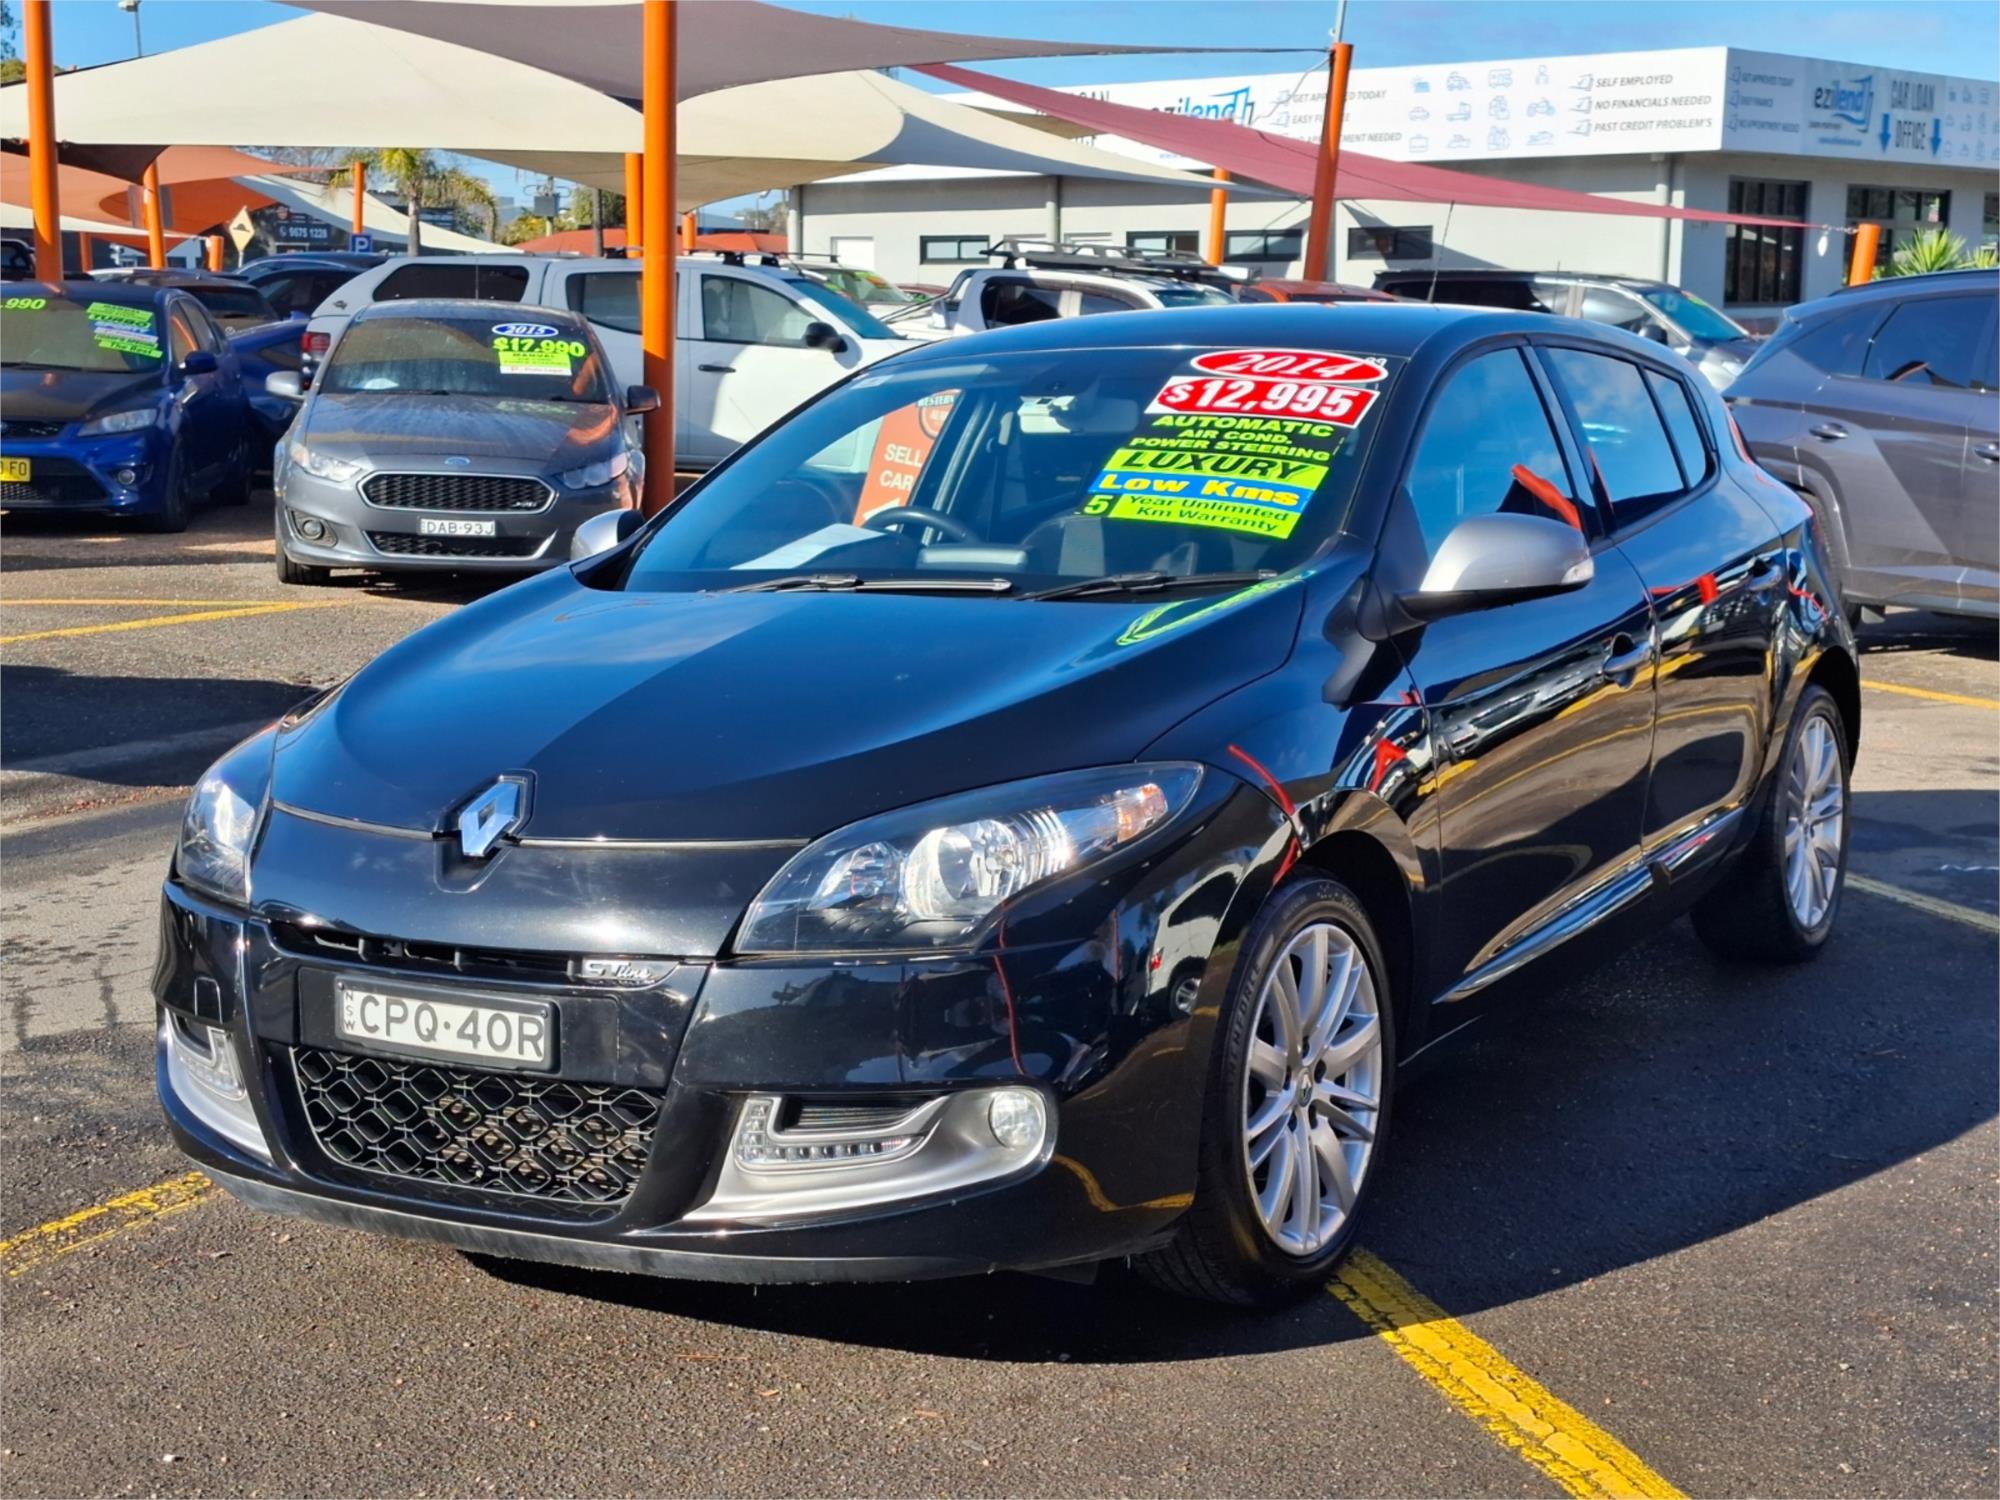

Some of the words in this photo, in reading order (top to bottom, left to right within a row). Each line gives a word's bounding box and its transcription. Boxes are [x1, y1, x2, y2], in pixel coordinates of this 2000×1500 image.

[1596, 78, 1618, 88] SELF
[1619, 74, 1673, 87] EMPLOYED
[1595, 100, 1610, 110] NO
[1612, 97, 1669, 109] FINANCIALS
[1670, 95, 1712, 106] NEEDED
[1594, 121, 1618, 132] PAST
[1619, 120, 1654, 131] CREDIT
[1222, 353, 1357, 379] 2014
[1163, 379, 1361, 417] $12,995
[1151, 414, 1335, 438] AUTOMATIC
[1180, 428, 1217, 440] AIR
[1223, 430, 1293, 444] COND.
[884, 443, 923, 467] SELL
[1130, 436, 1207, 450] POWER
[1213, 440, 1331, 462] STEERING
[1121, 451, 1311, 480] LUXURY
[880, 470, 915, 491] CAR
[1099, 474, 1190, 493] Low
[1200, 479, 1301, 507] Kms
[1084, 494, 1112, 516] 5
[1129, 495, 1176, 508] Year
[1182, 498, 1289, 522] Unlimited
[1136, 506, 1174, 518] Km
[1180, 510, 1280, 533] Warranty
